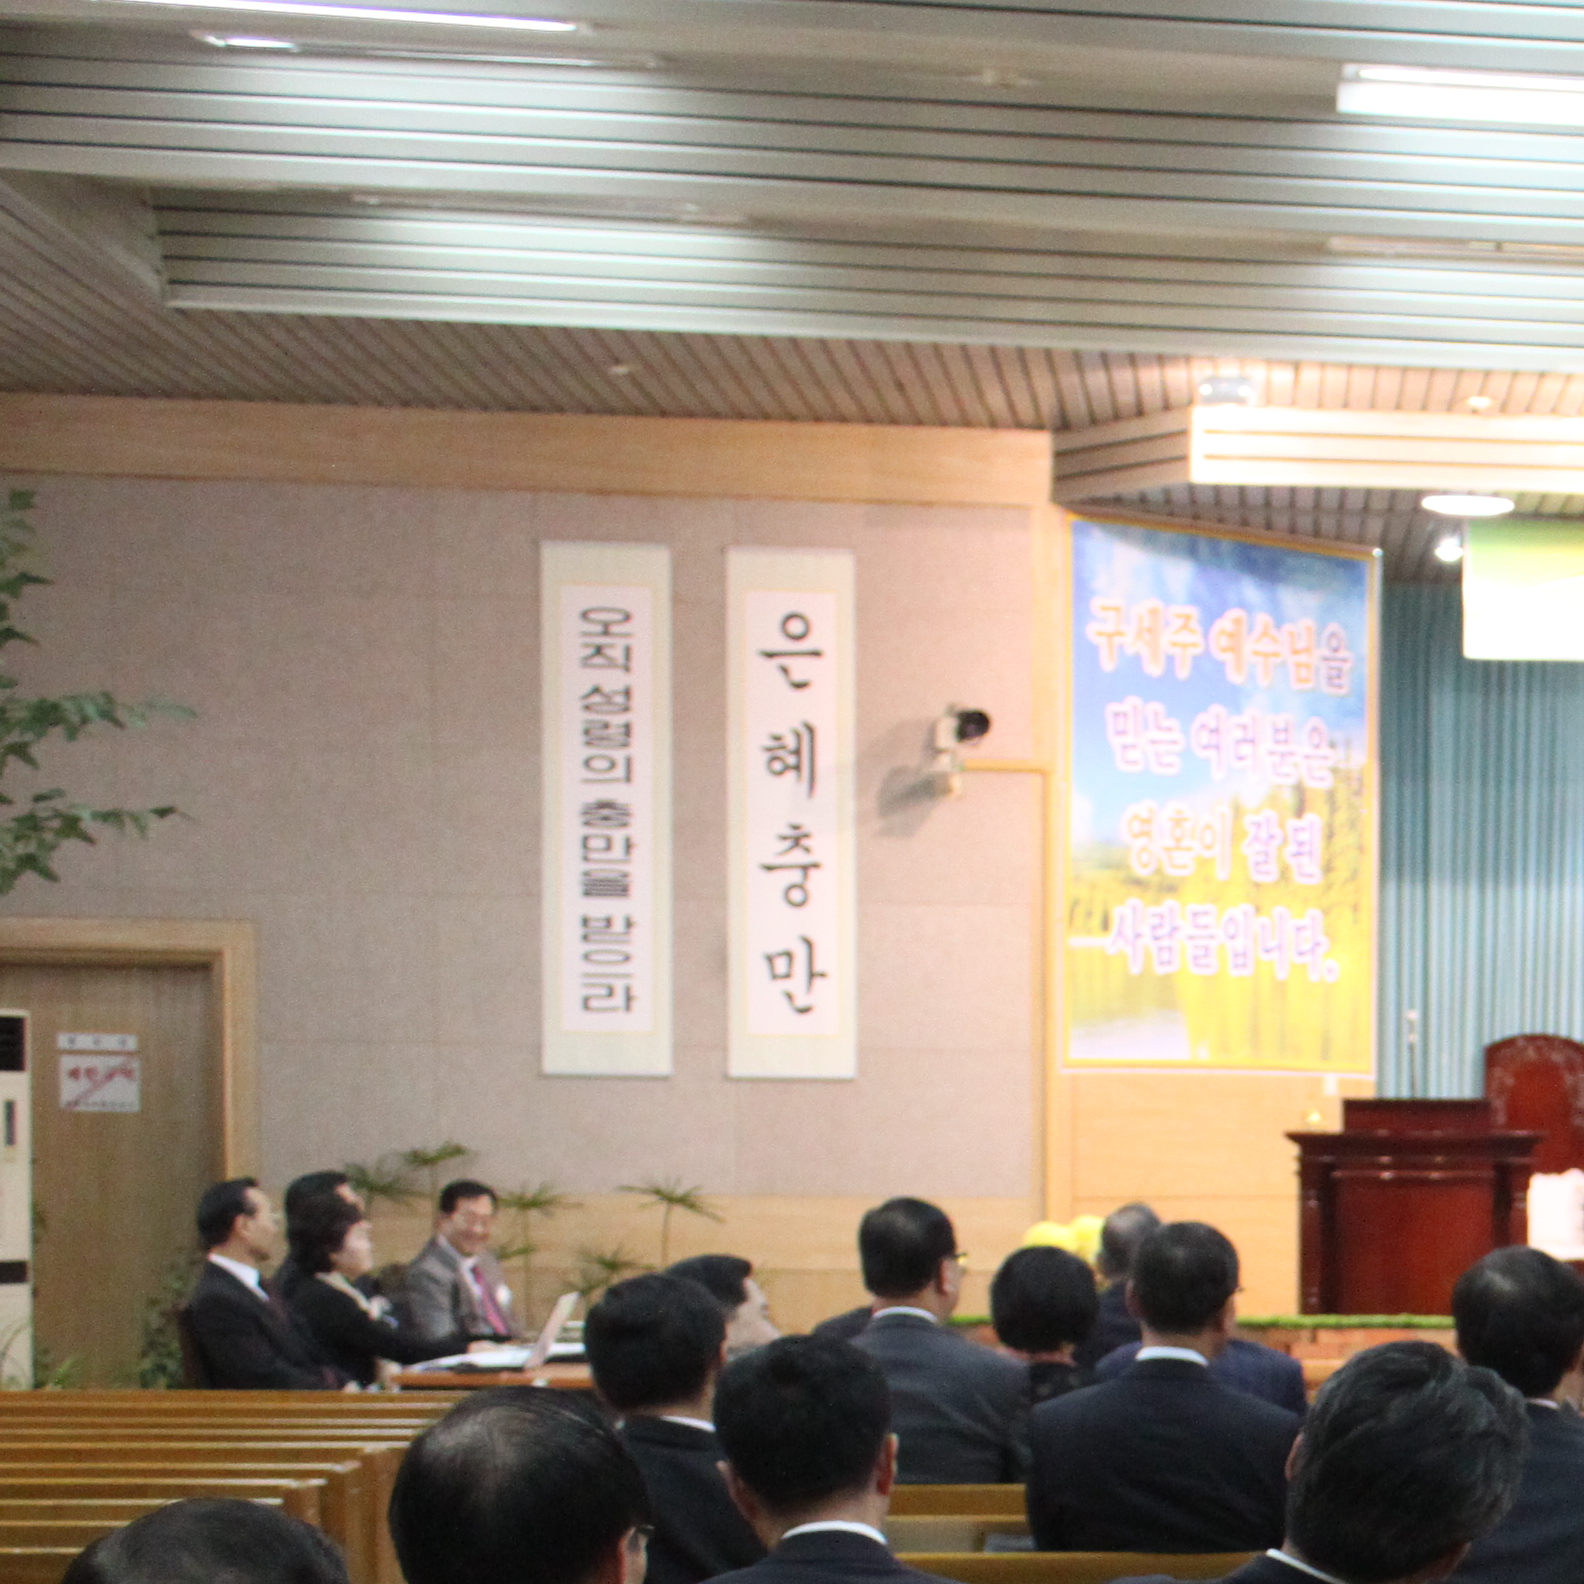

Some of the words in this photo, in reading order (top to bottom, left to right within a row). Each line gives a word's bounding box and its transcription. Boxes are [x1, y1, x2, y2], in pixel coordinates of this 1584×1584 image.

[578, 605, 634, 673] 오직
[1088, 599, 1204, 678] 구세주
[1210, 609, 1353, 694] 예수님을
[578, 684, 634, 784] 성령의
[1107, 698, 1184, 773] 믿는
[1192, 706, 1334, 785] 여러분은
[1122, 801, 1231, 879] 영혼이
[1244, 811, 1321, 882] 잘된
[578, 914, 637, 1013] 받으라
